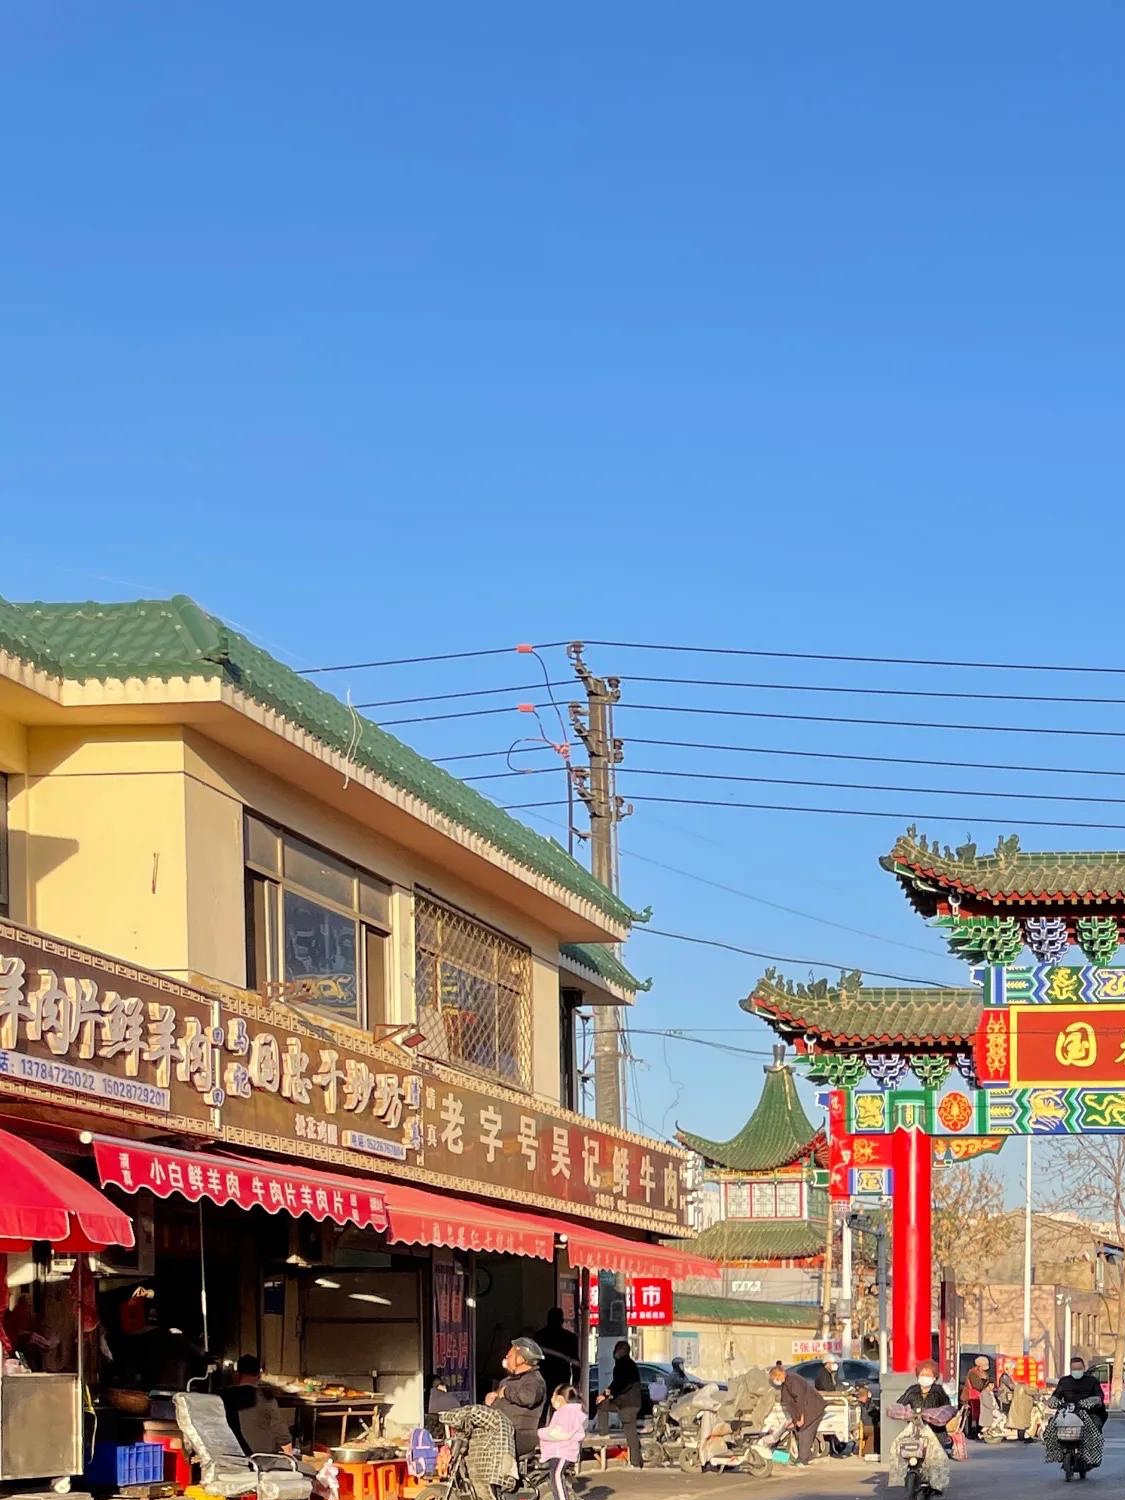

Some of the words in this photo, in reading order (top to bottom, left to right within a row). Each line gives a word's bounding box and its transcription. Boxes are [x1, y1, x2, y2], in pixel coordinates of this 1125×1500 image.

[150, 1158, 240, 1198] 小白鲜羊肉
[252, 1176, 343, 1215] 牛肉片羊肉片
